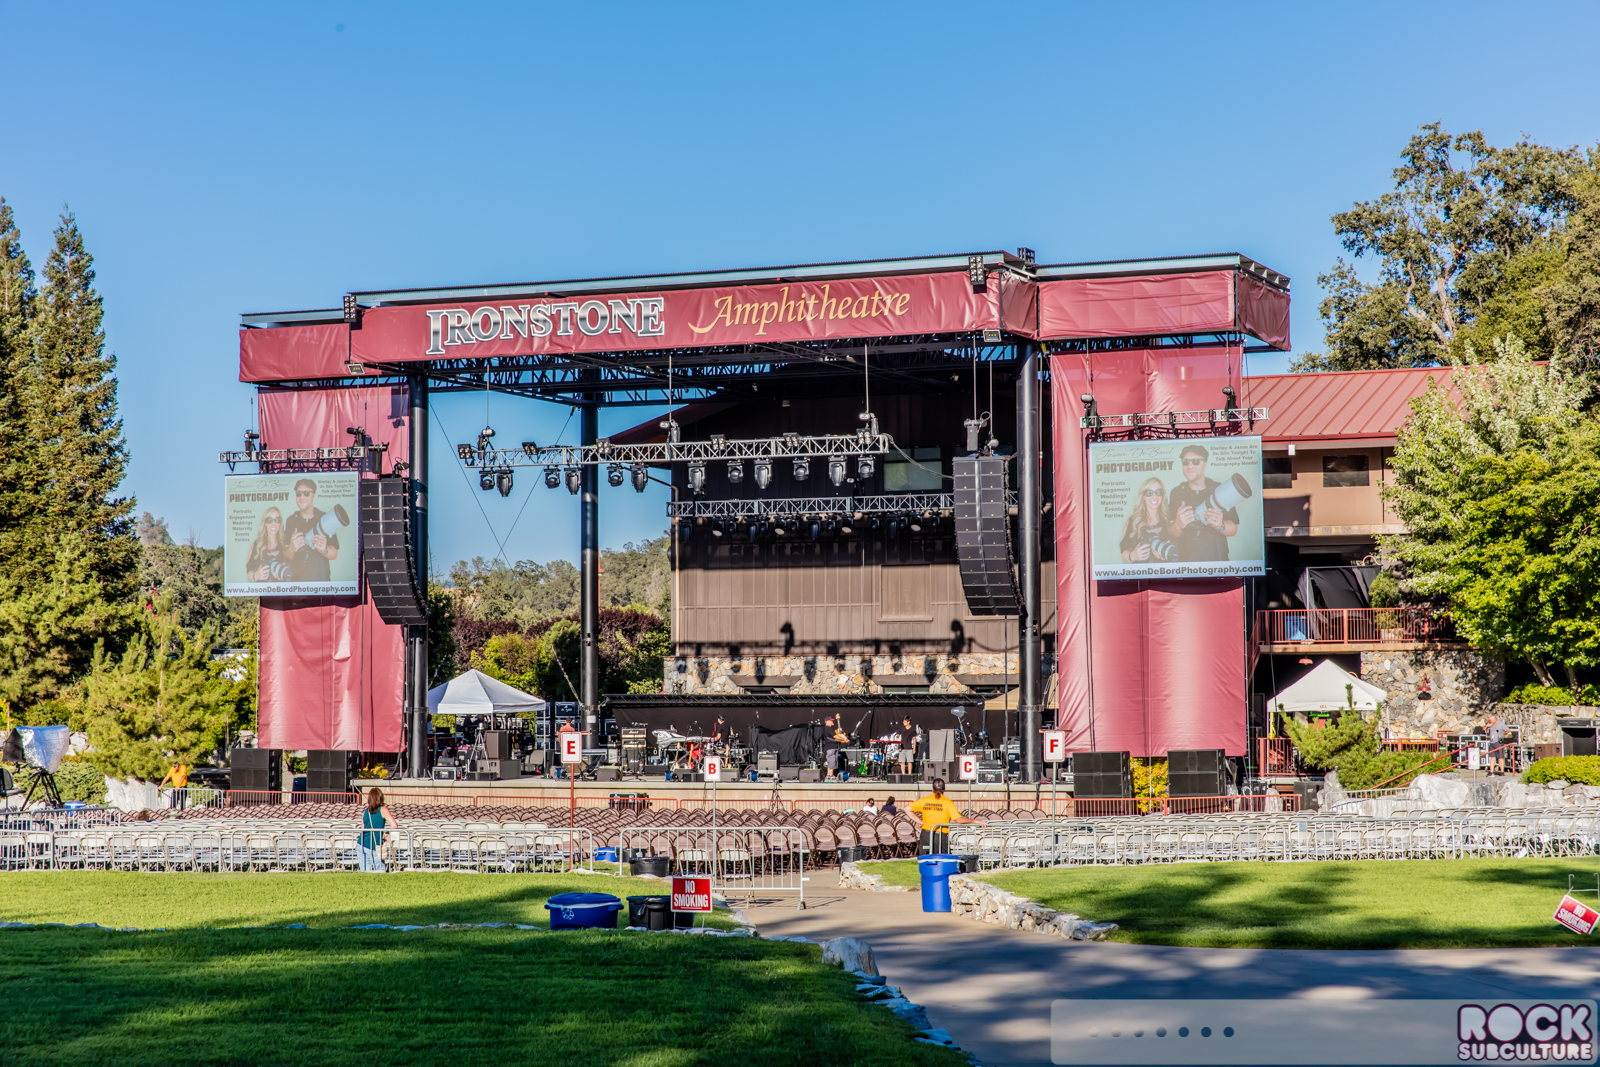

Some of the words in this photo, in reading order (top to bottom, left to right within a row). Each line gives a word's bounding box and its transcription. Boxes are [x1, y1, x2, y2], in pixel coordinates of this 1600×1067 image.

[426, 297, 664, 355] IRONSTONE
[688, 284, 910, 335] Amphitheatre
[1096, 461, 1174, 473] PHOTOGRAPHY
[229, 492, 290, 502] PHOTOGRAPHY
[1095, 566, 1262, 576] www.JasonDeBordPhotography.com
[567, 741, 575, 754] E
[1050, 739, 1058, 753] F
[709, 763, 716, 774] B
[964, 761, 972, 773] C
[685, 880, 695, 893] NO
[674, 894, 708, 907] SMOKING
[1573, 905, 1586, 917] NO
[1558, 908, 1591, 933] SMOKING
